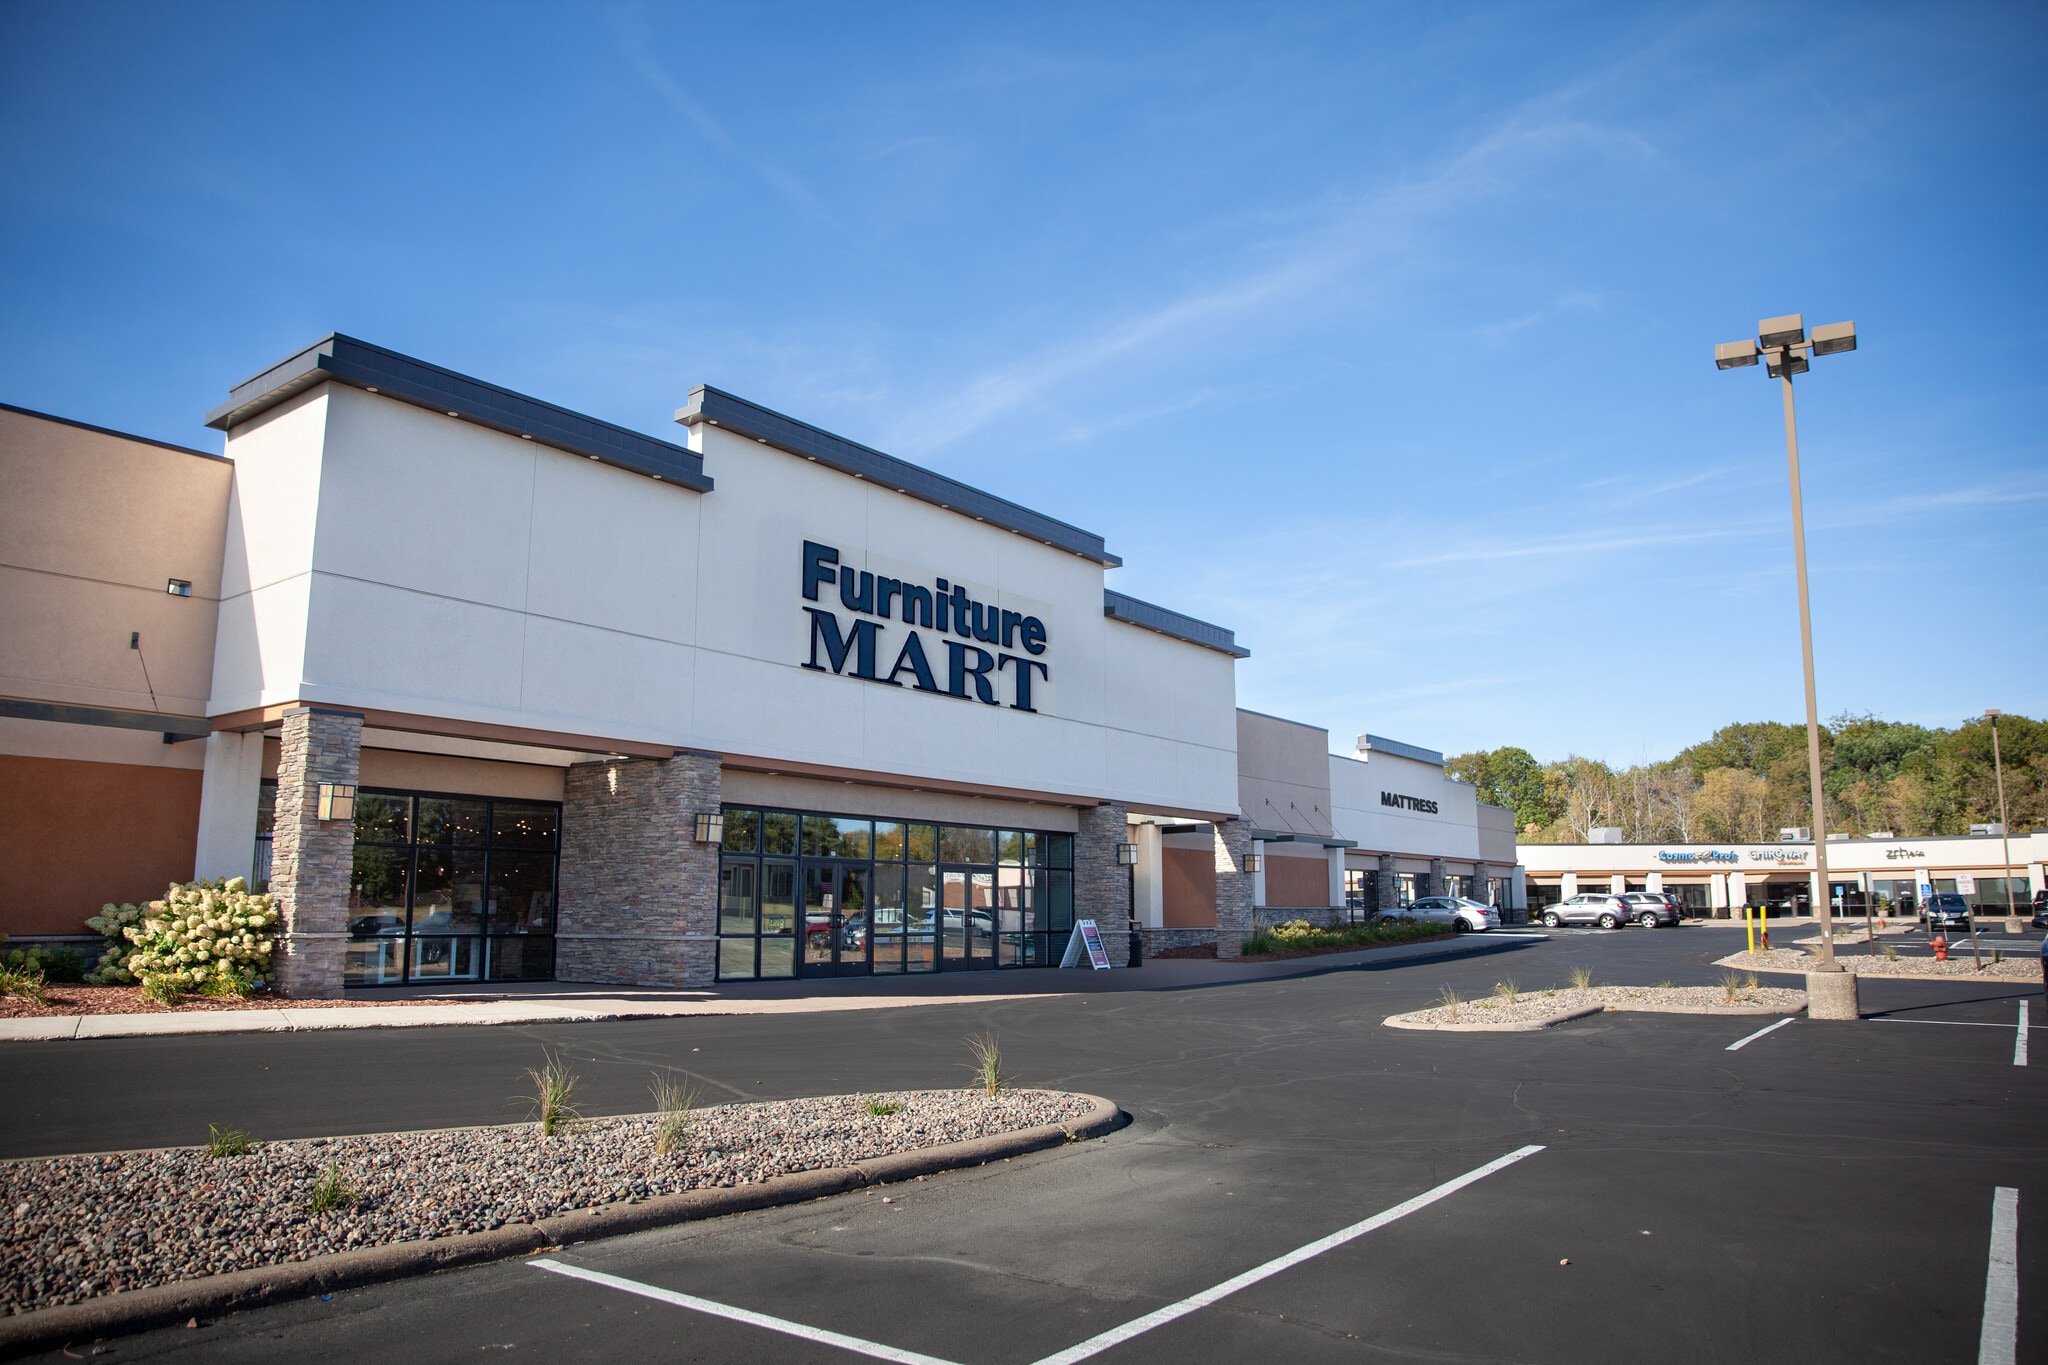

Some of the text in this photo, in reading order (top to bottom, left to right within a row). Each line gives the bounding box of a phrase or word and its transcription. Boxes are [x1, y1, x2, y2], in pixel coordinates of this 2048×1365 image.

[802, 540, 1047, 655] Furniture
[801, 606, 1049, 713] MART
[1381, 791, 1438, 814] MATTRESS
[1659, 850, 1736, 860] Cosmo Prof
